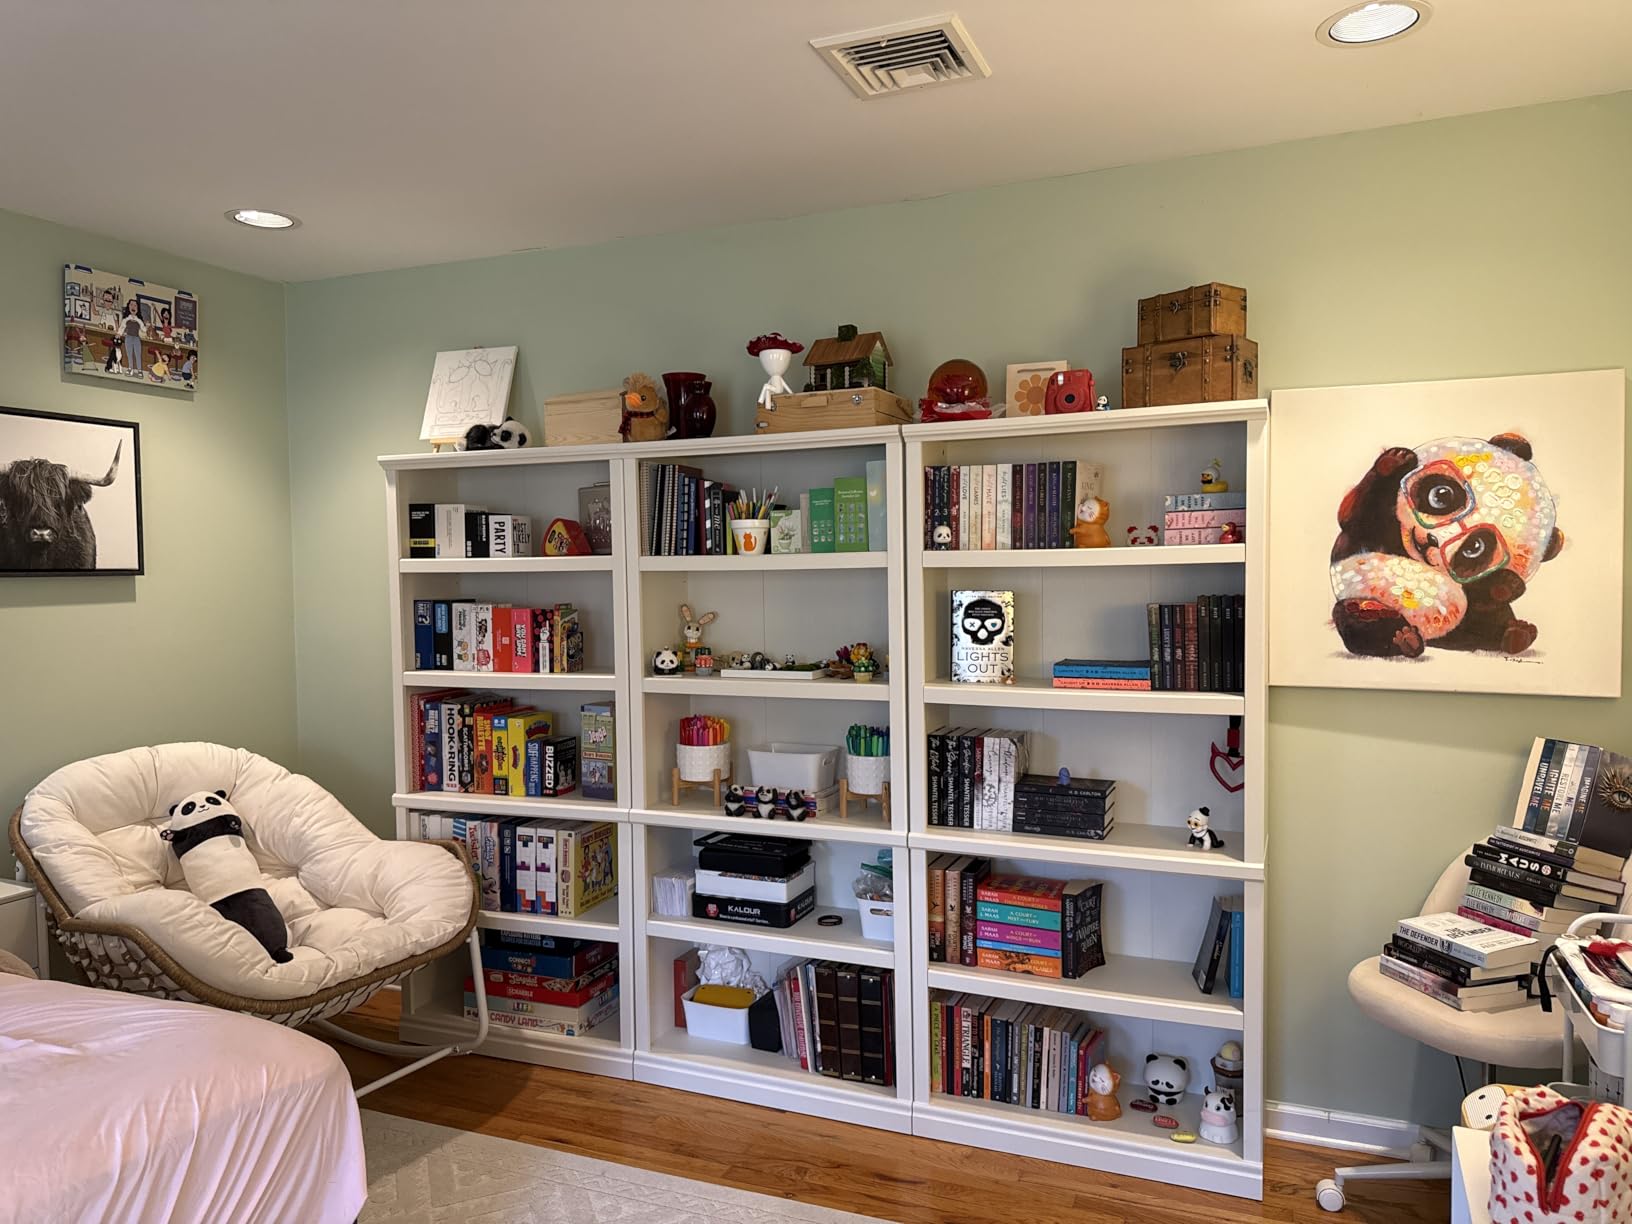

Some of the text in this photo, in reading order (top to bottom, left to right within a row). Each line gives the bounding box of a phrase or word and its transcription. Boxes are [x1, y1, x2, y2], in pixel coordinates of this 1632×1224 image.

[494, 521, 506, 554] PARTY
[512, 523, 526, 534] MOST
[512, 533, 530, 544] LIKELY
[957, 652, 1008, 662] LIGHTS
[968, 664, 998, 674] OUT
[447, 708, 455, 745] HOOK
[476, 716, 486, 750] ROULETTE
[528, 742, 538, 757] STUFF
[448, 751, 456, 782] RING
[530, 757, 538, 782] HAPPENS
[545, 746, 554, 788] BUZZED
[1530, 762, 1548, 808] UNRAVEL ME
[1540, 769, 1560, 812] IGNITE ME
[1552, 774, 1570, 814] RESTORE ME
[1579, 776, 1592, 805] IMAGINE
[468, 824, 479, 861] Twister
[1498, 852, 1540, 872] MAUS
[1466, 898, 1476, 906] ELLE
[1476, 900, 1495, 914] KENNEDY
[1471, 888, 1503, 904] ELLE KENNEDY
[728, 904, 760, 915] KALOUR
[1398, 926, 1439, 947] THE DEFENDER
[490, 1012, 538, 1028] CANDY LAND
[962, 1024, 970, 1064] TRIANGLE
